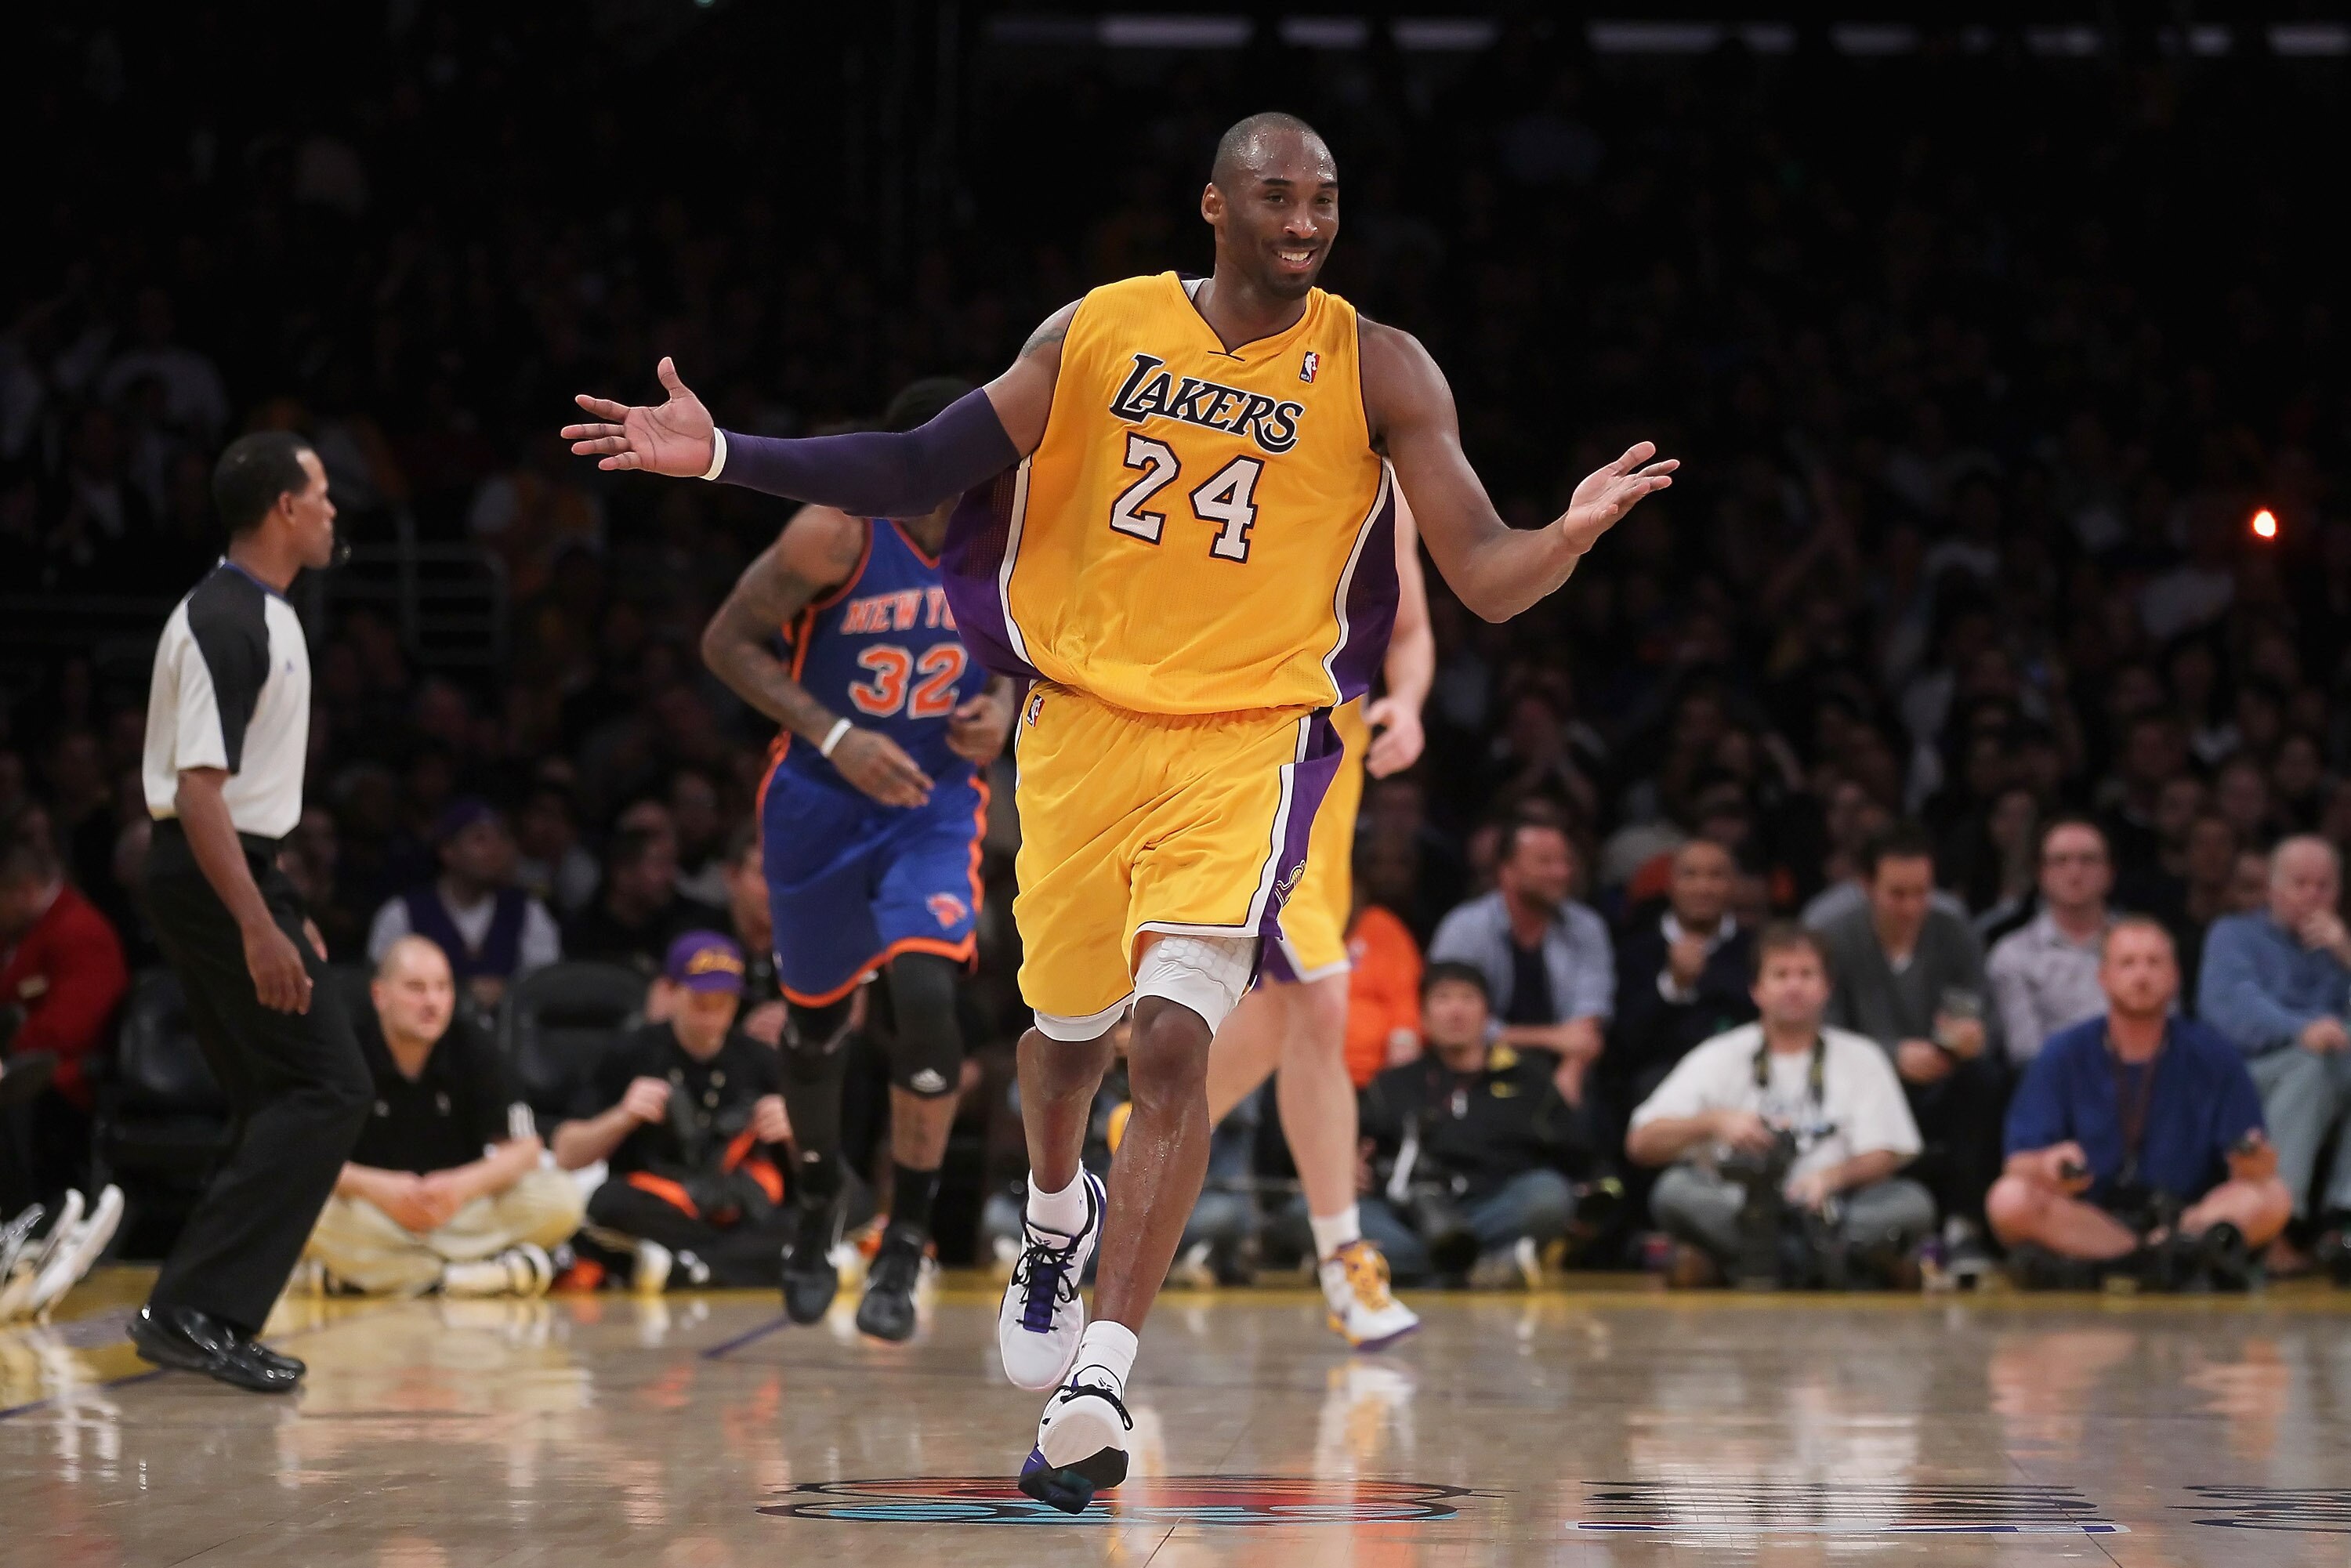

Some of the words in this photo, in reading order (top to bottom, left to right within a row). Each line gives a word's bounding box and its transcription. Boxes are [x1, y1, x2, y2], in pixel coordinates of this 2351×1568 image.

[1109, 352, 1306, 454] LAKERS
[1109, 431, 1266, 564] 24
[840, 589, 922, 635] NEW
[849, 643, 969, 719] 32
